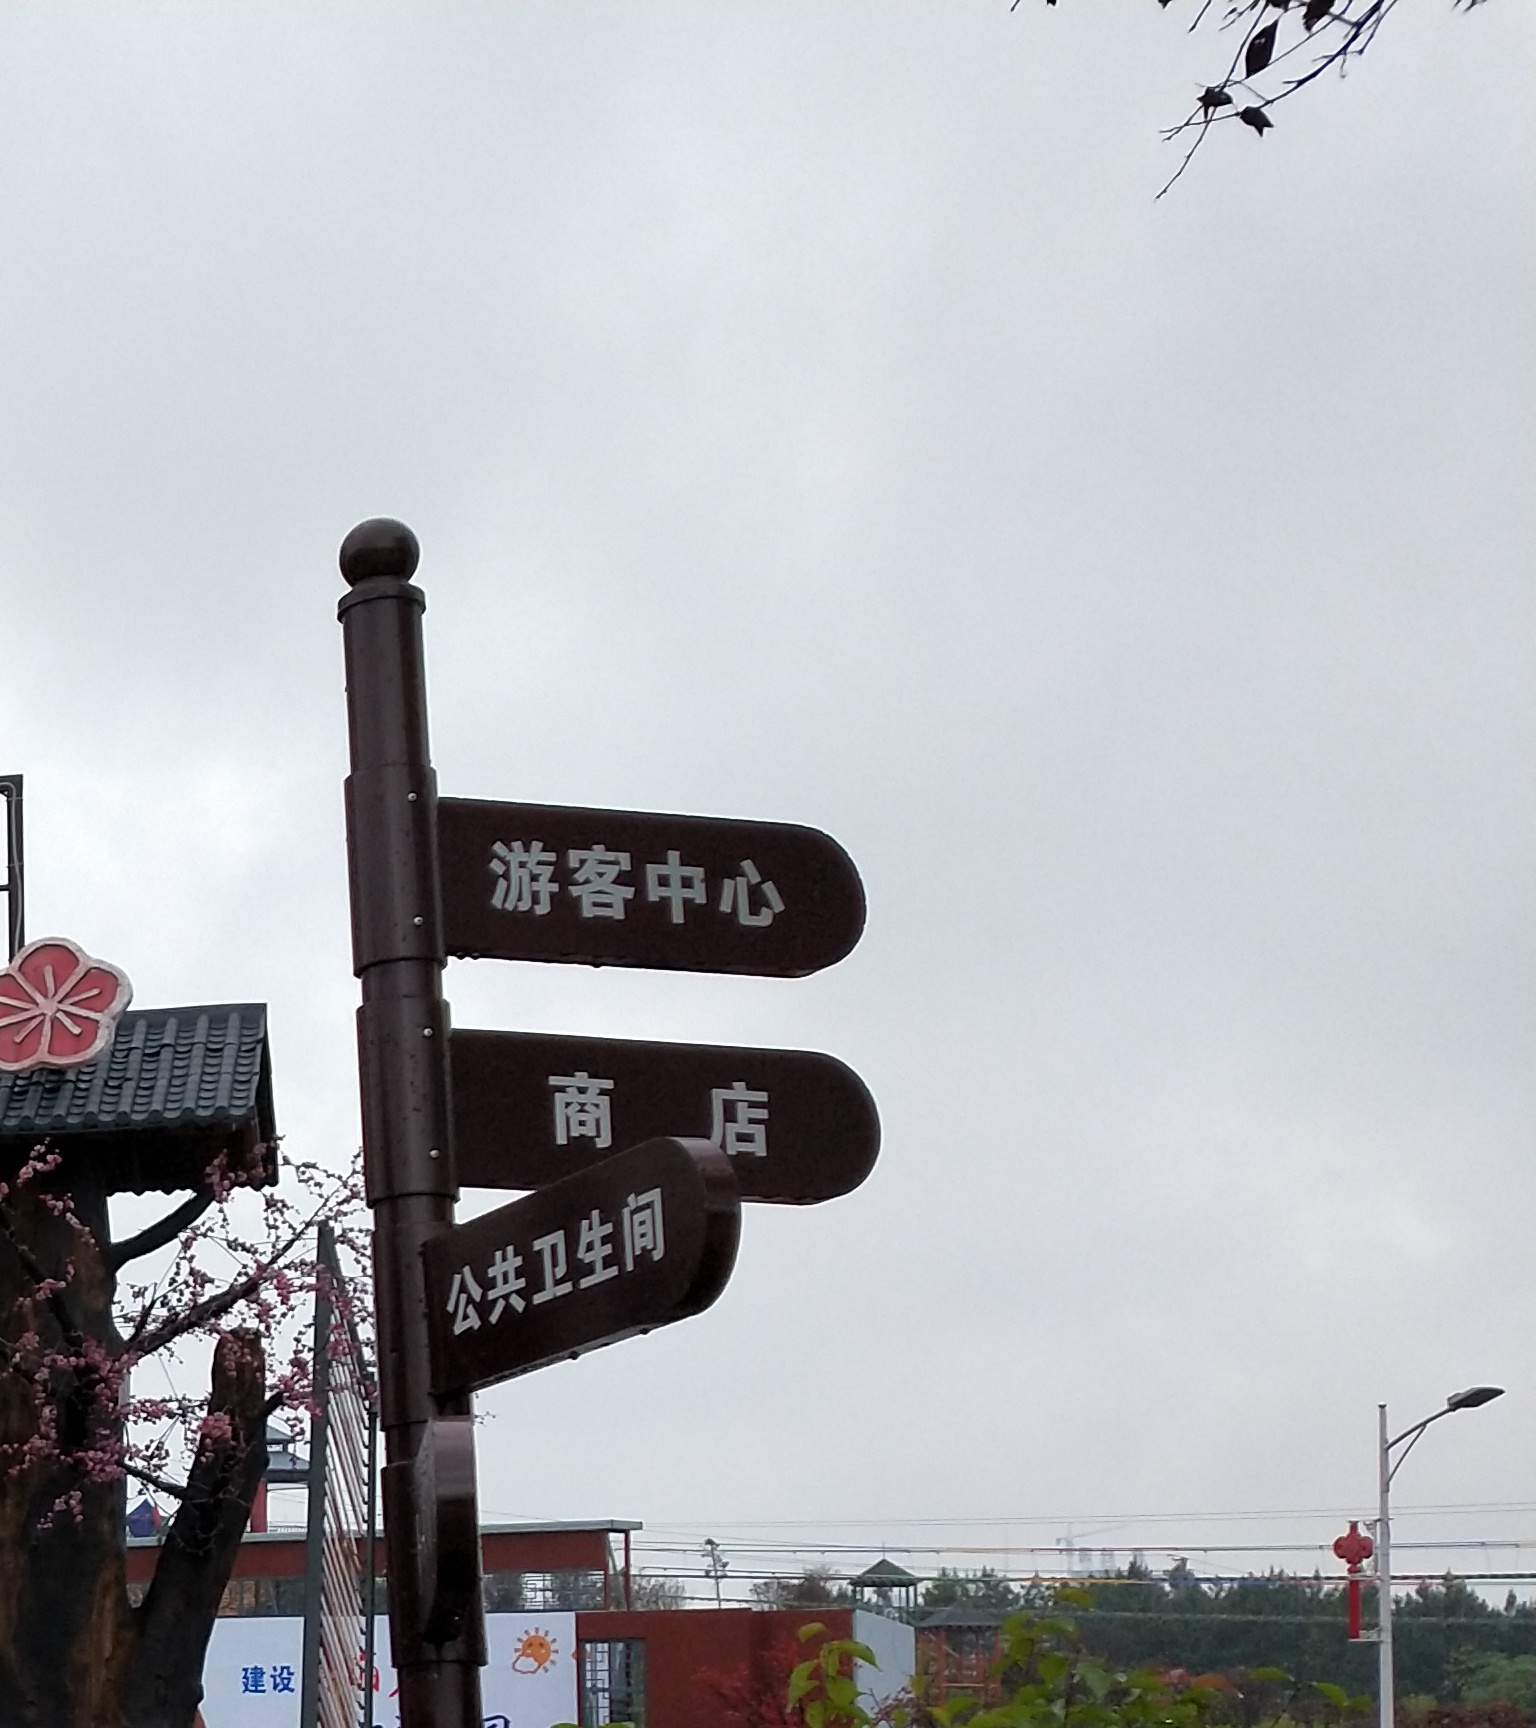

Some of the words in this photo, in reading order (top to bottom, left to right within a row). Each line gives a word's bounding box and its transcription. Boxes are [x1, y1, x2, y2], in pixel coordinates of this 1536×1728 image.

[488, 840, 785, 928] 游客中心
[548, 1071, 769, 1158] 商店
[446, 1187, 665, 1337] 公共卫生间
[242, 1665, 296, 1694] 建设
